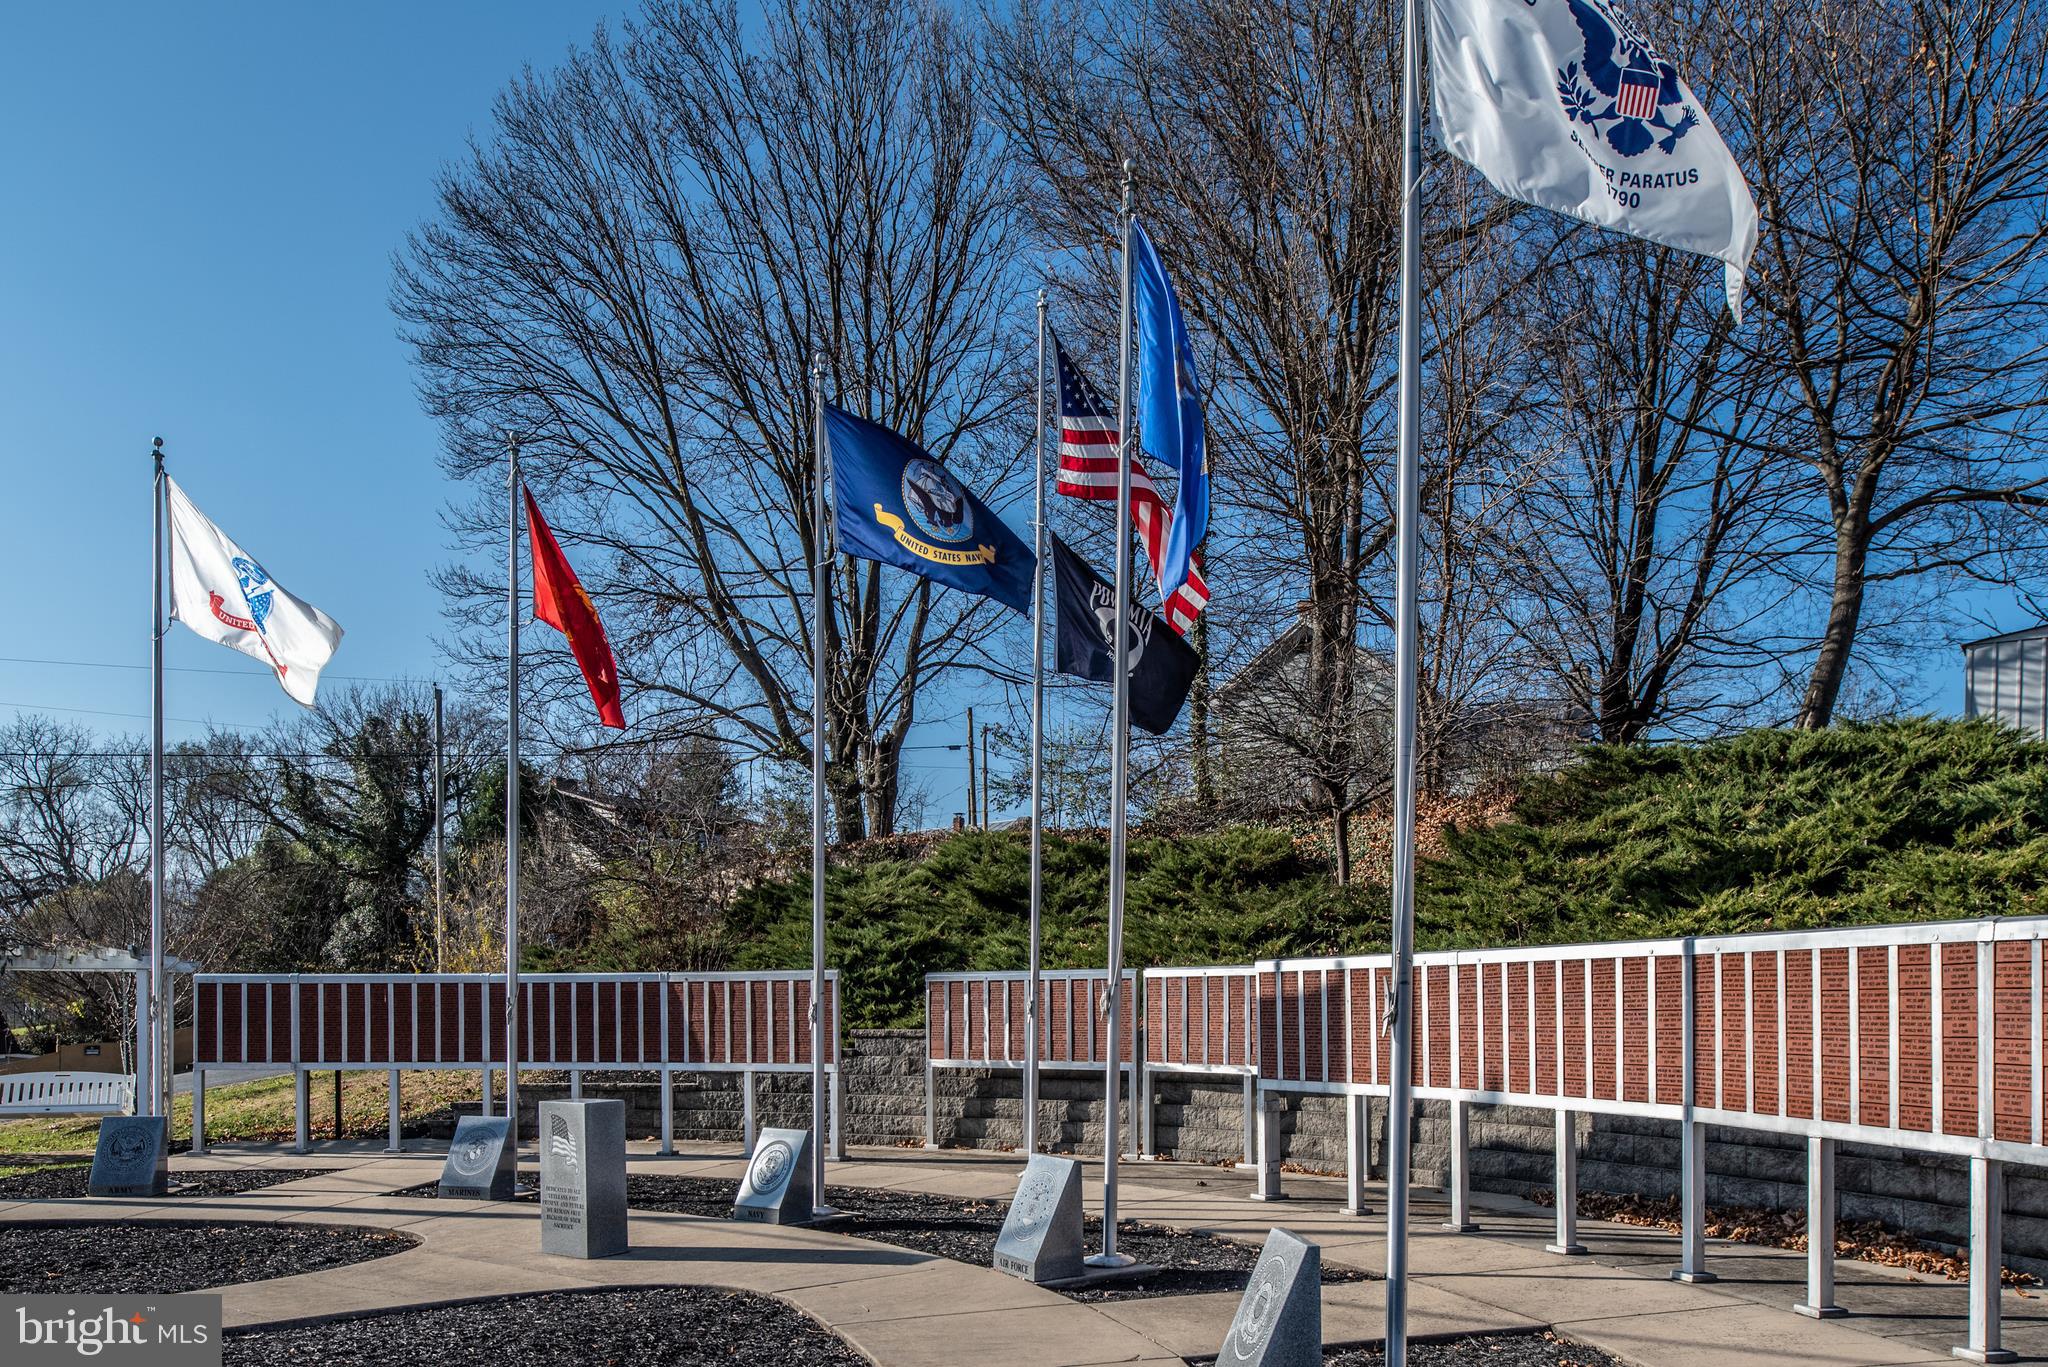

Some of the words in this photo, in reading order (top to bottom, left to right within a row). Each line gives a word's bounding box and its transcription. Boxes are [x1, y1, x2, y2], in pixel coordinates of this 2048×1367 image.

[1570, 130, 1615, 183] SEER
[1620, 168, 1699, 189] PARATUS
[1606, 182, 1640, 209] 1790
[900, 534, 929, 556] UNITED
[933, 550, 961, 562] STATES
[218, 611, 255, 629] UNITED
[747, 1210, 764, 1219] NAVY
[999, 1258, 1009, 1269] AIR
[1010, 1260, 1029, 1275] FORCE
